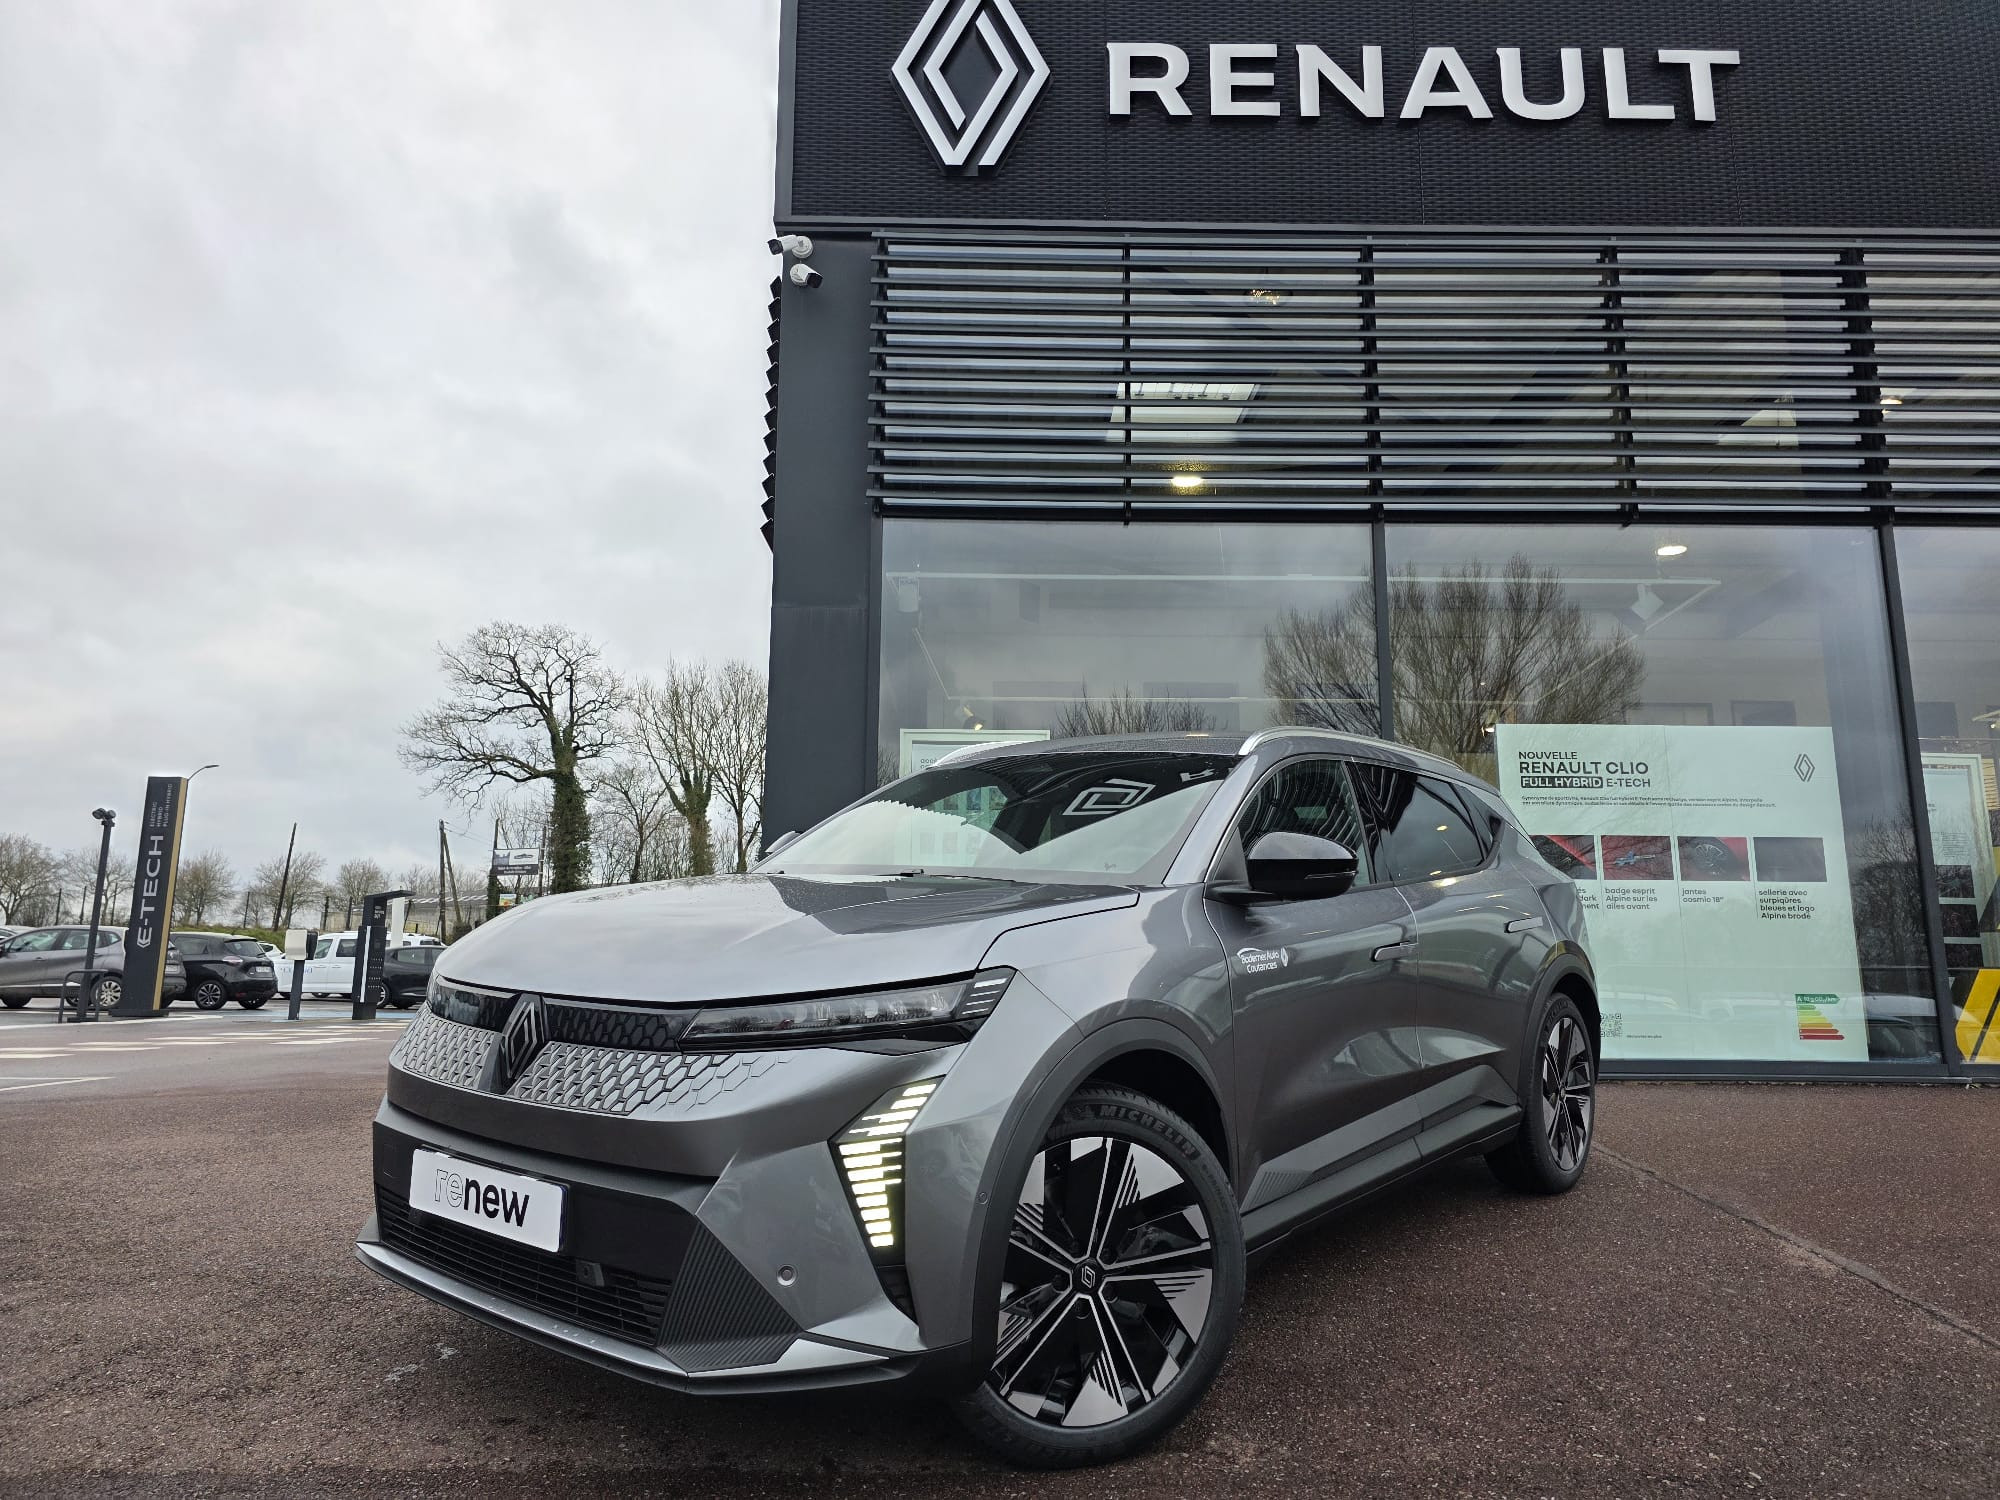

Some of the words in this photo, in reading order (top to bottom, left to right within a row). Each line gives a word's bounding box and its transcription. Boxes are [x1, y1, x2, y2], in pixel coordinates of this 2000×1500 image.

[1106, 42, 1740, 122] RENAULT
[1518, 751, 1578, 760] NOUVELLE
[1519, 761, 1602, 774] RENAULT
[1605, 761, 1649, 775] CLIO
[1522, 777, 1553, 787] FULL
[1555, 777, 1602, 788] HYBRID
[1606, 778, 1651, 788] E-TECH
[136, 835, 164, 949] E-TECH
[1604, 887, 1631, 897] badge
[1632, 887, 1656, 897] esprit
[1681, 888, 1707, 897] jantes
[1758, 888, 1788, 896] sellerie
[1606, 895, 1631, 904] Alpine
[1797, 904, 1815, 913] logo
[1761, 912, 1786, 920] Alpine
[1246, 961, 1278, 974] Coutances
[1100, 1104, 1197, 1158] MICHELIN
[434, 1168, 530, 1227] renew
